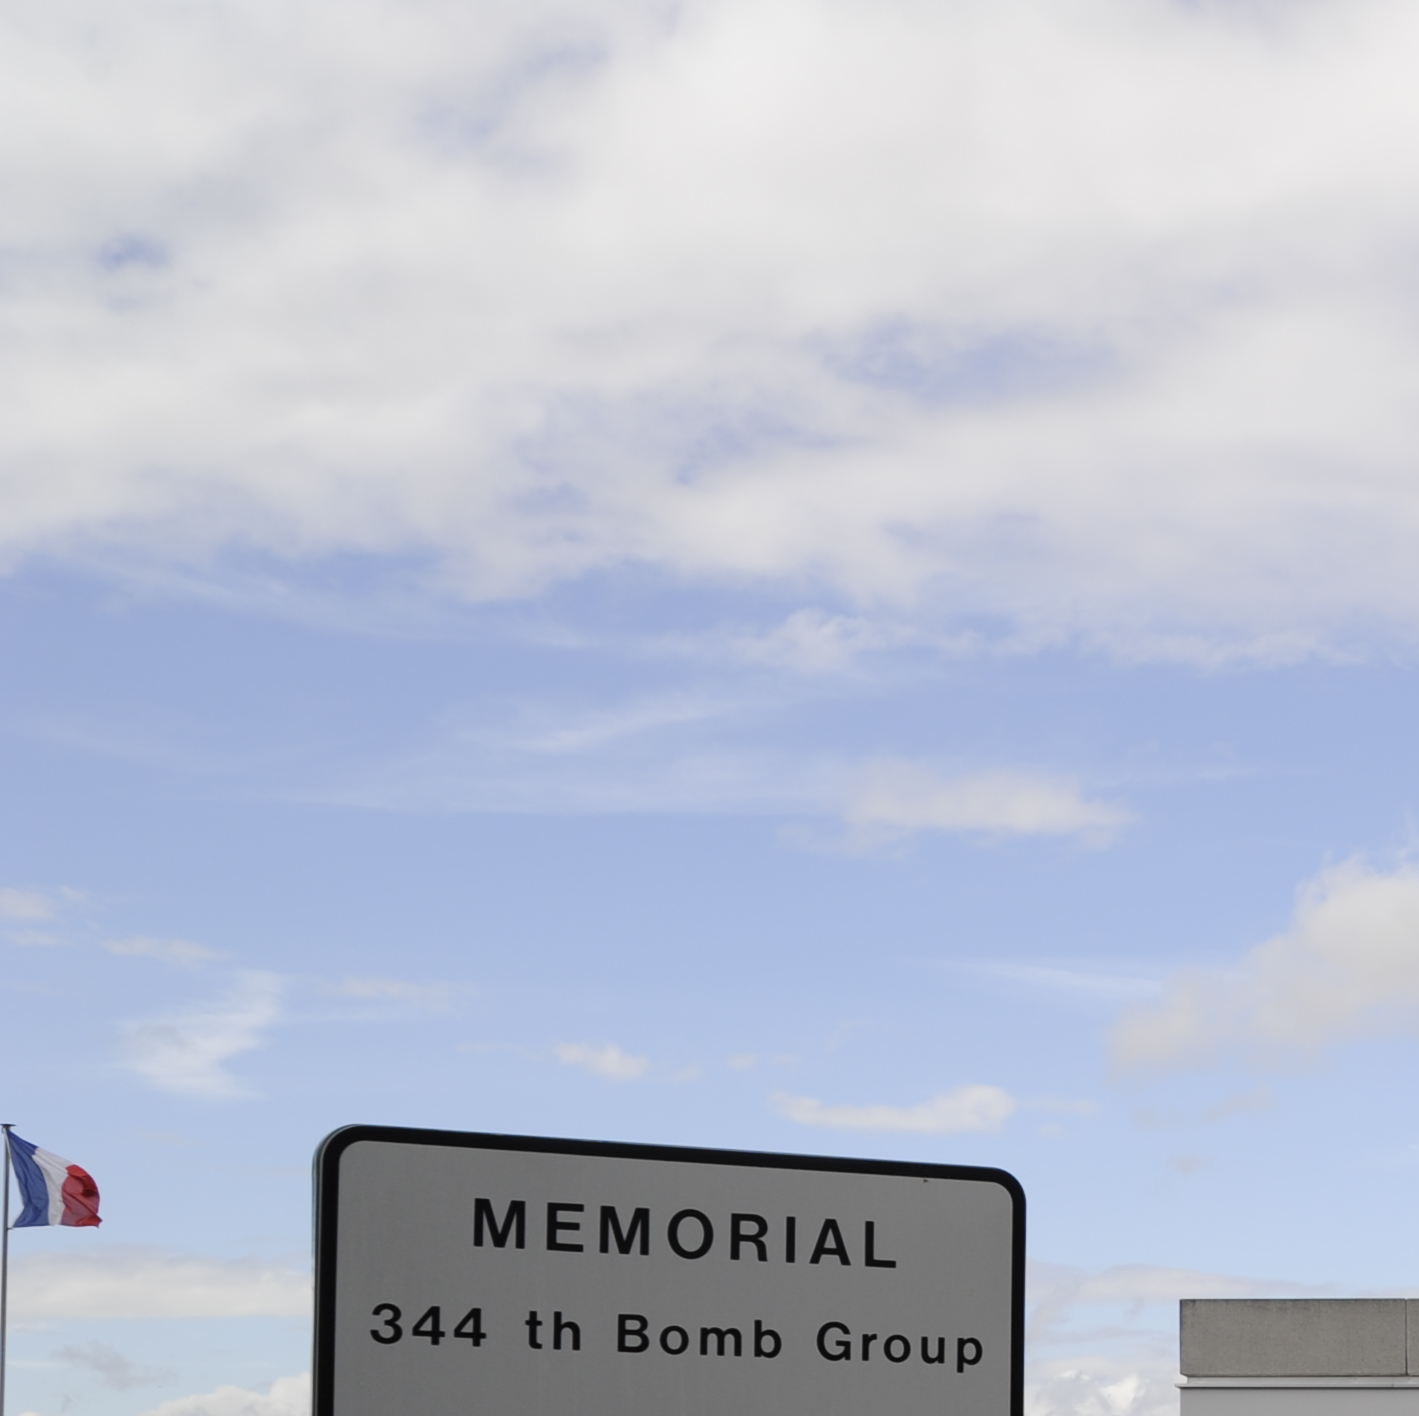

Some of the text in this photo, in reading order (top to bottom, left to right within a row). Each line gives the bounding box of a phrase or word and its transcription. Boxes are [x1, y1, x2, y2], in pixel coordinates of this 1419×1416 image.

[473, 1197, 898, 1269] MEMORIAL
[369, 1302, 984, 1374] 344 th Bomb Group
